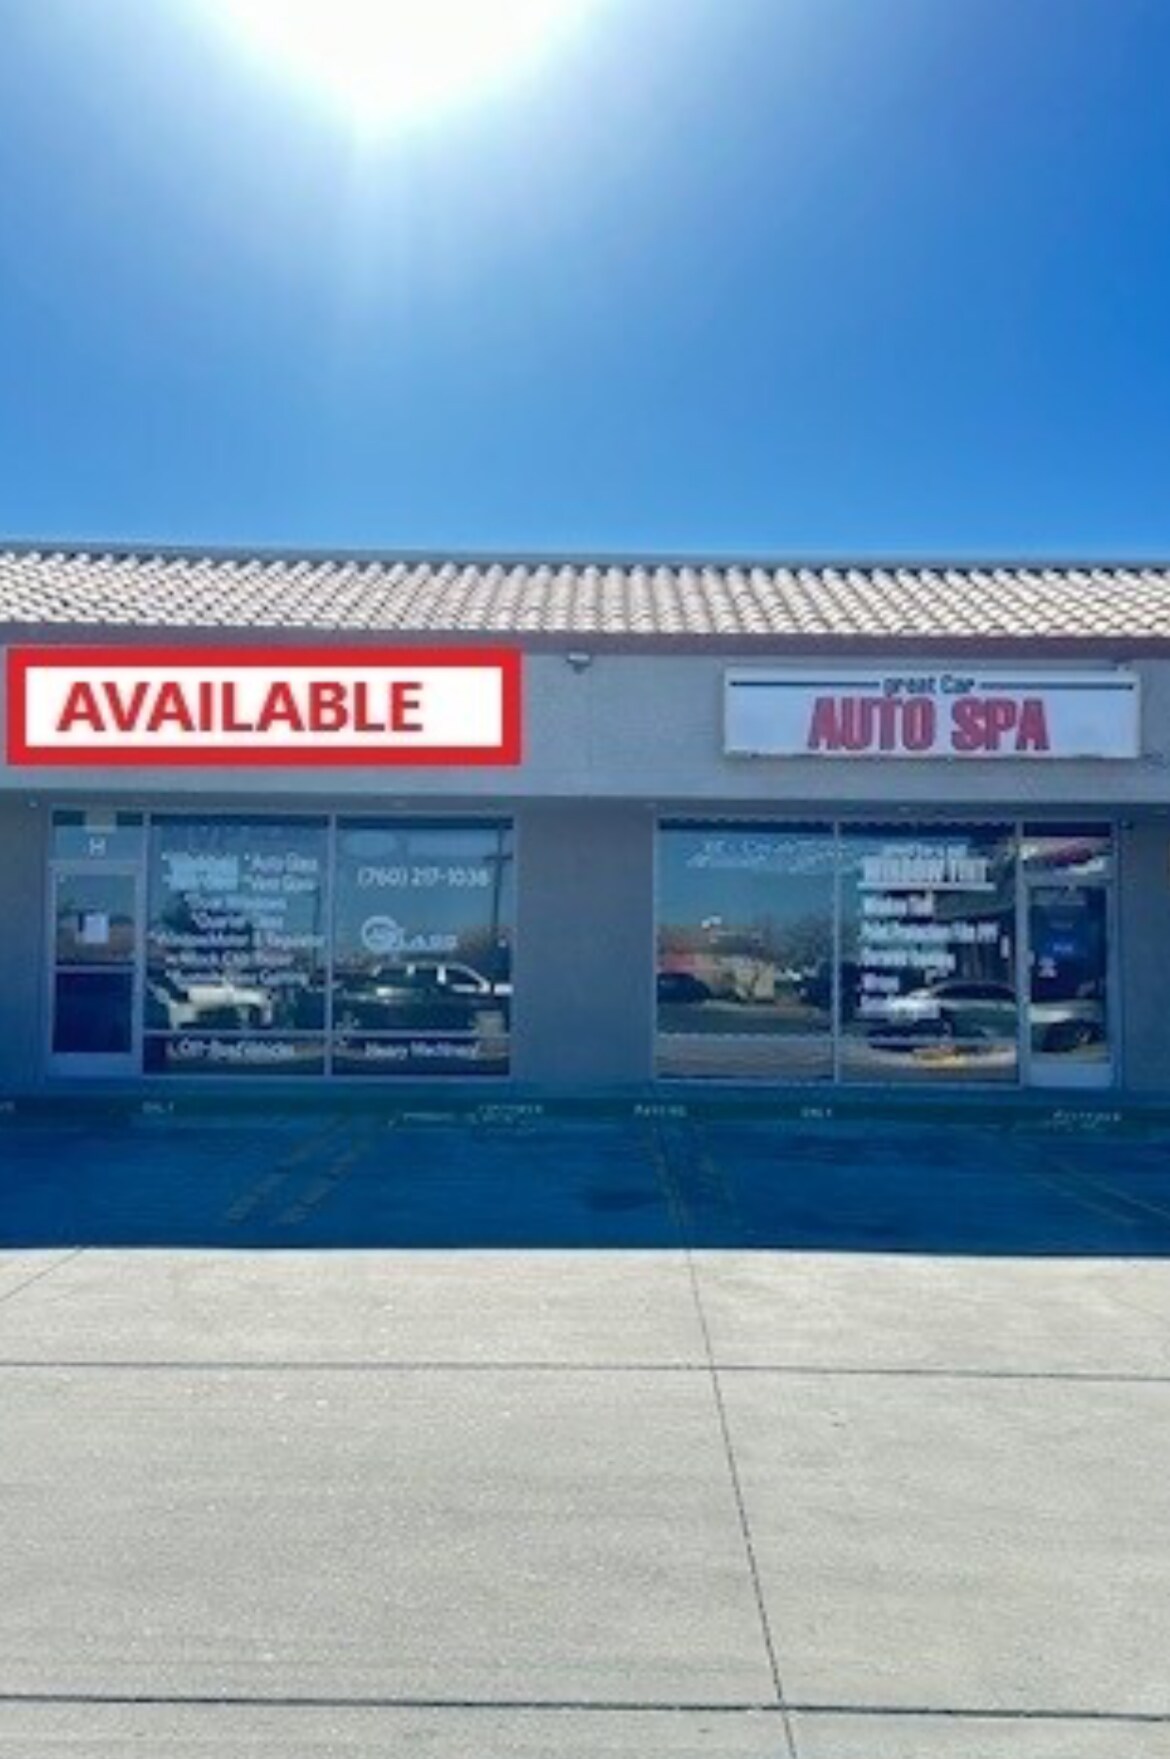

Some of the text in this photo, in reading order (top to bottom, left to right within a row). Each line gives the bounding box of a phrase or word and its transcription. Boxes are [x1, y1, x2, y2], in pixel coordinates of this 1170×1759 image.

[883, 675, 975, 697] great Car
[807, 697, 1050, 751] AUTO SPA
